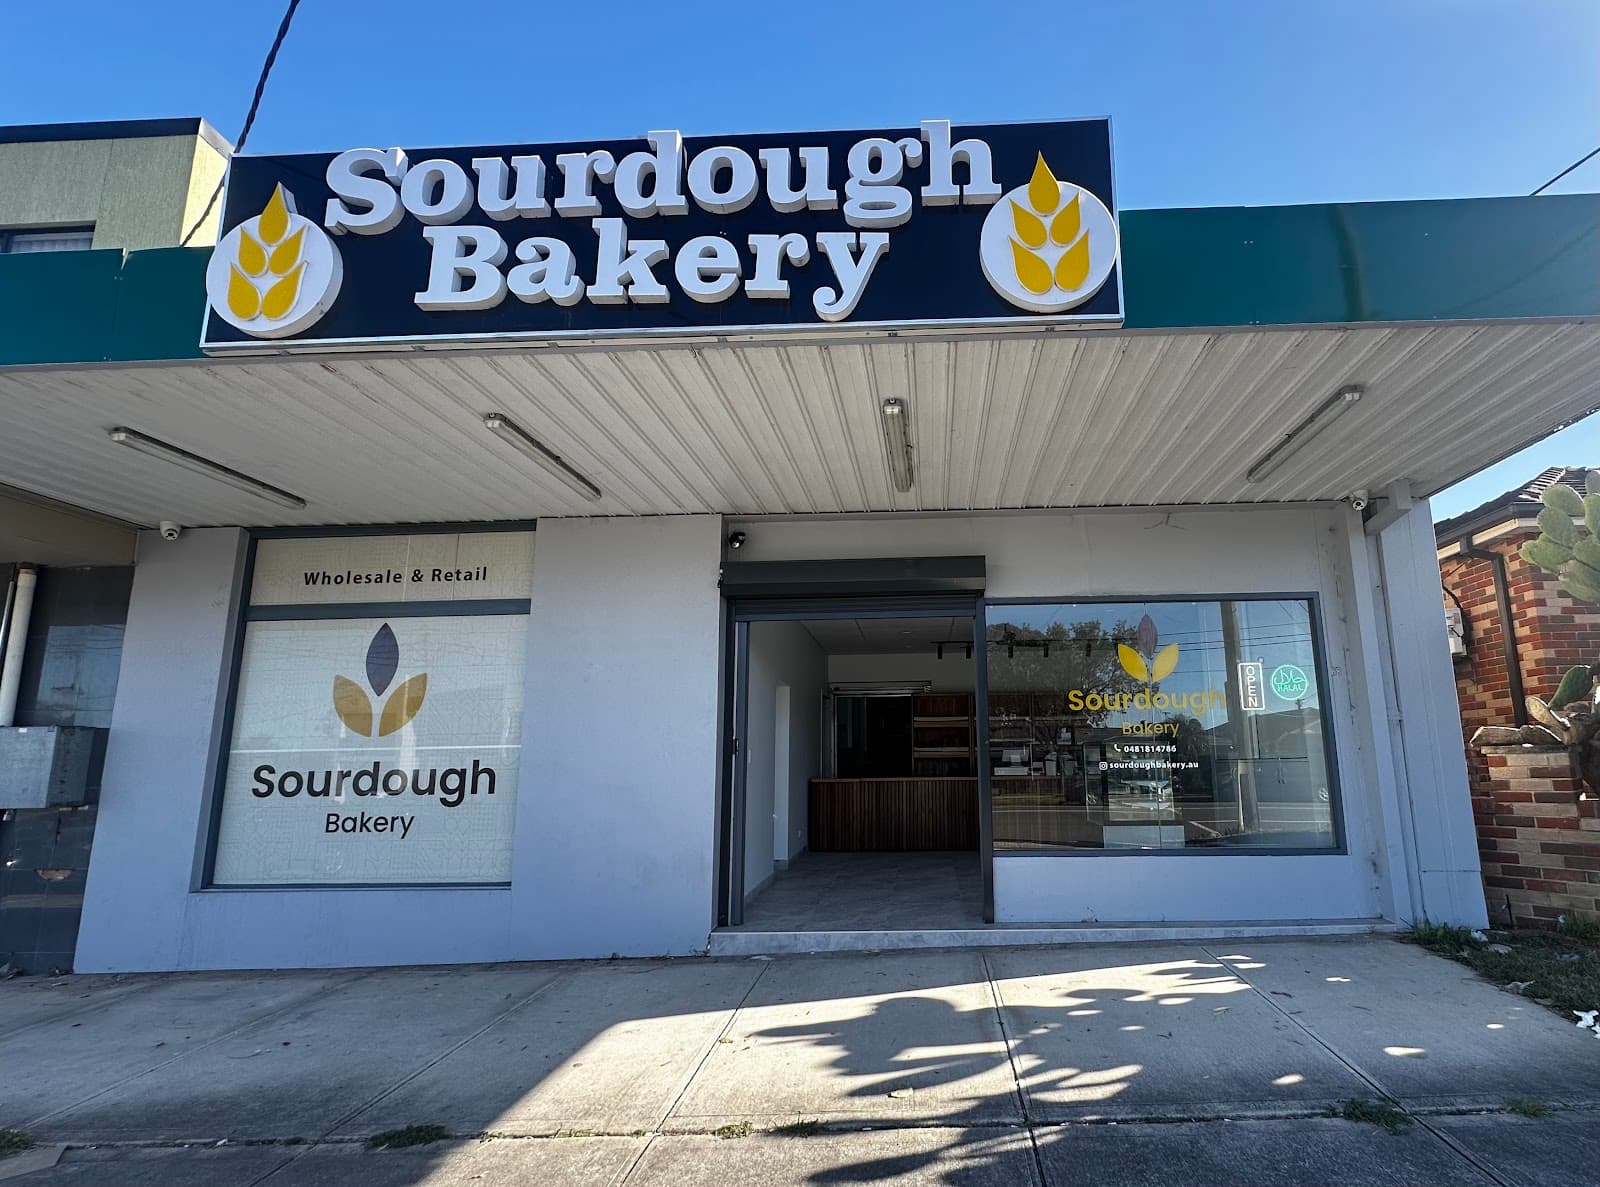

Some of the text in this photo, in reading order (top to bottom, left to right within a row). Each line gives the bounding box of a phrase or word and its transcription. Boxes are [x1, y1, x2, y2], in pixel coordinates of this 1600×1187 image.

[324, 120, 1002, 235] Sourdough
[414, 218, 890, 322] Bakery
[304, 567, 487, 585] Wholesale & Retail
[1246, 666, 1258, 707] OPEN
[1278, 683, 1304, 692] HALAL
[1068, 688, 1226, 717] Sourdough
[1122, 721, 1180, 737] Bakery
[1109, 761, 1199, 770] sourdoughbakery.au
[252, 760, 497, 808] Sourdough
[324, 812, 415, 839] Bakery
